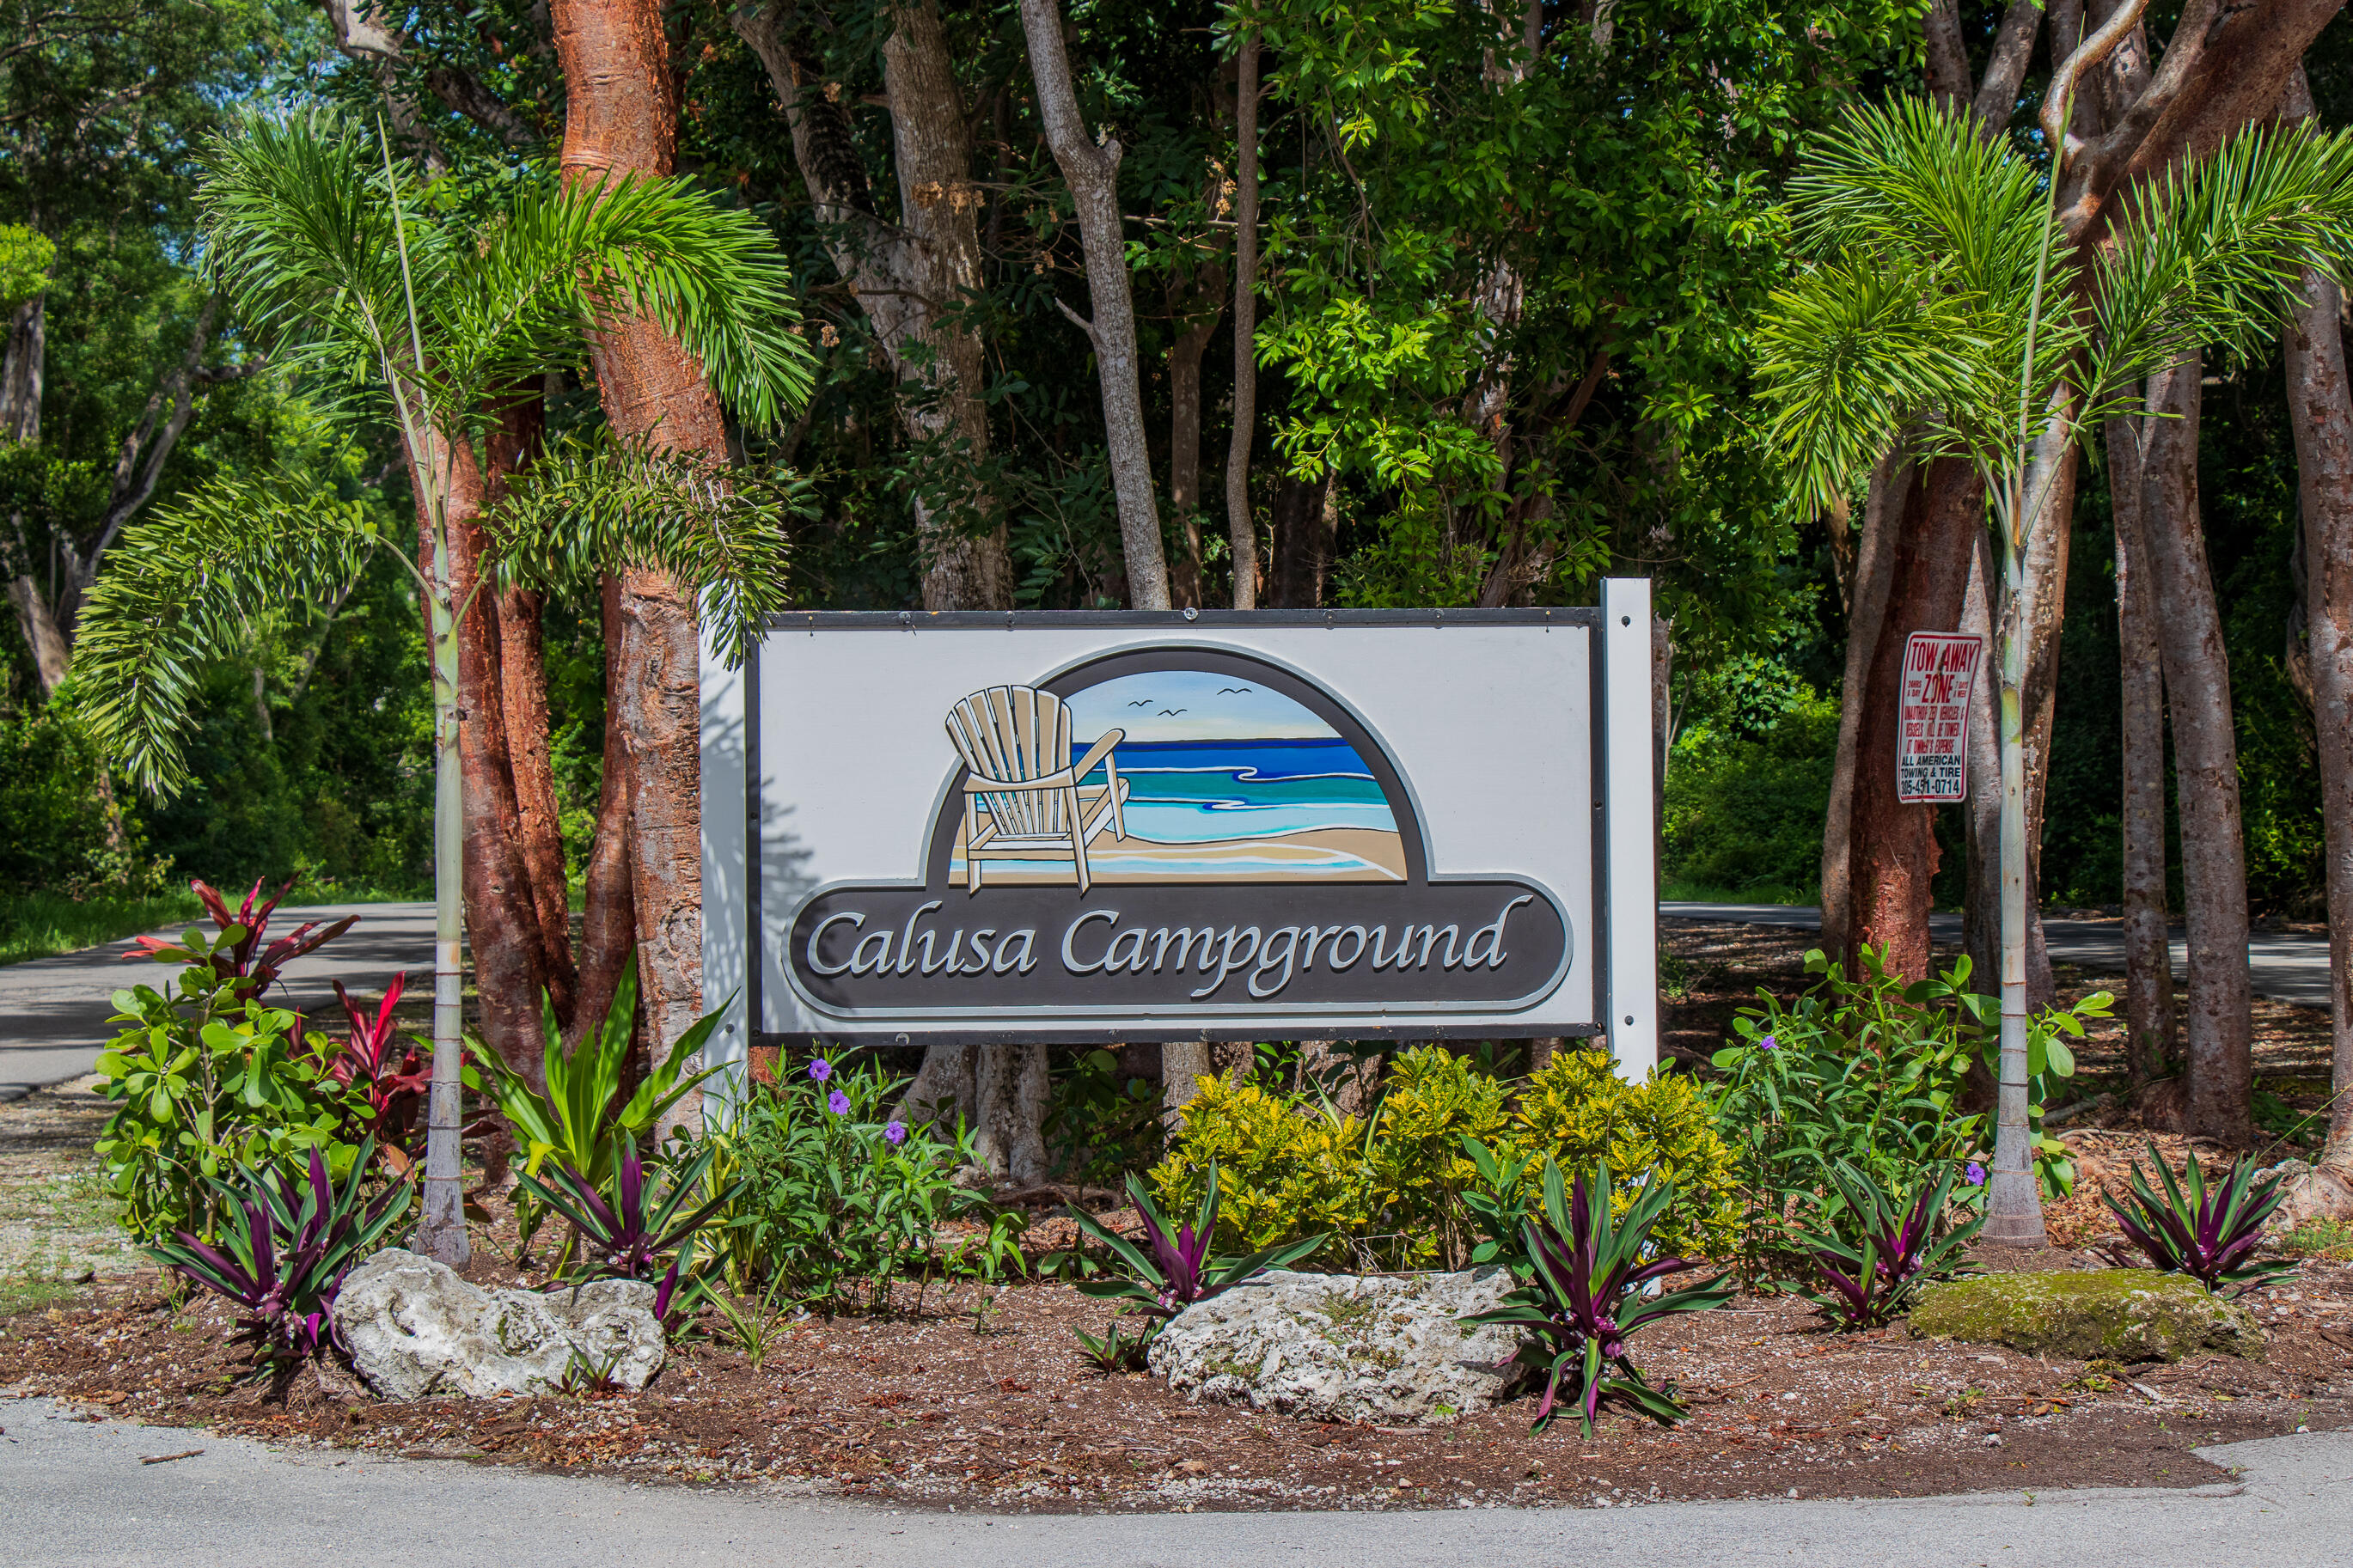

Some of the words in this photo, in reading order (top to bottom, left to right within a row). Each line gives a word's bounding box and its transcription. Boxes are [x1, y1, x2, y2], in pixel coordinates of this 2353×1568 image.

[1910, 642, 1939, 672] TOW
[1940, 643, 1979, 673] AWAY
[1921, 674, 1955, 704] ZONE
[1902, 756, 1914, 766] ALL
[1916, 755, 1960, 766] AMERICAN
[1901, 767, 1928, 778] TOWING
[1930, 767, 1936, 778] &
[1940, 767, 1961, 778] TIRE
[1901, 779, 1959, 795] 305-451-0714
[807, 900, 1038, 976] Calusa
[1060, 894, 1534, 998] Campground
